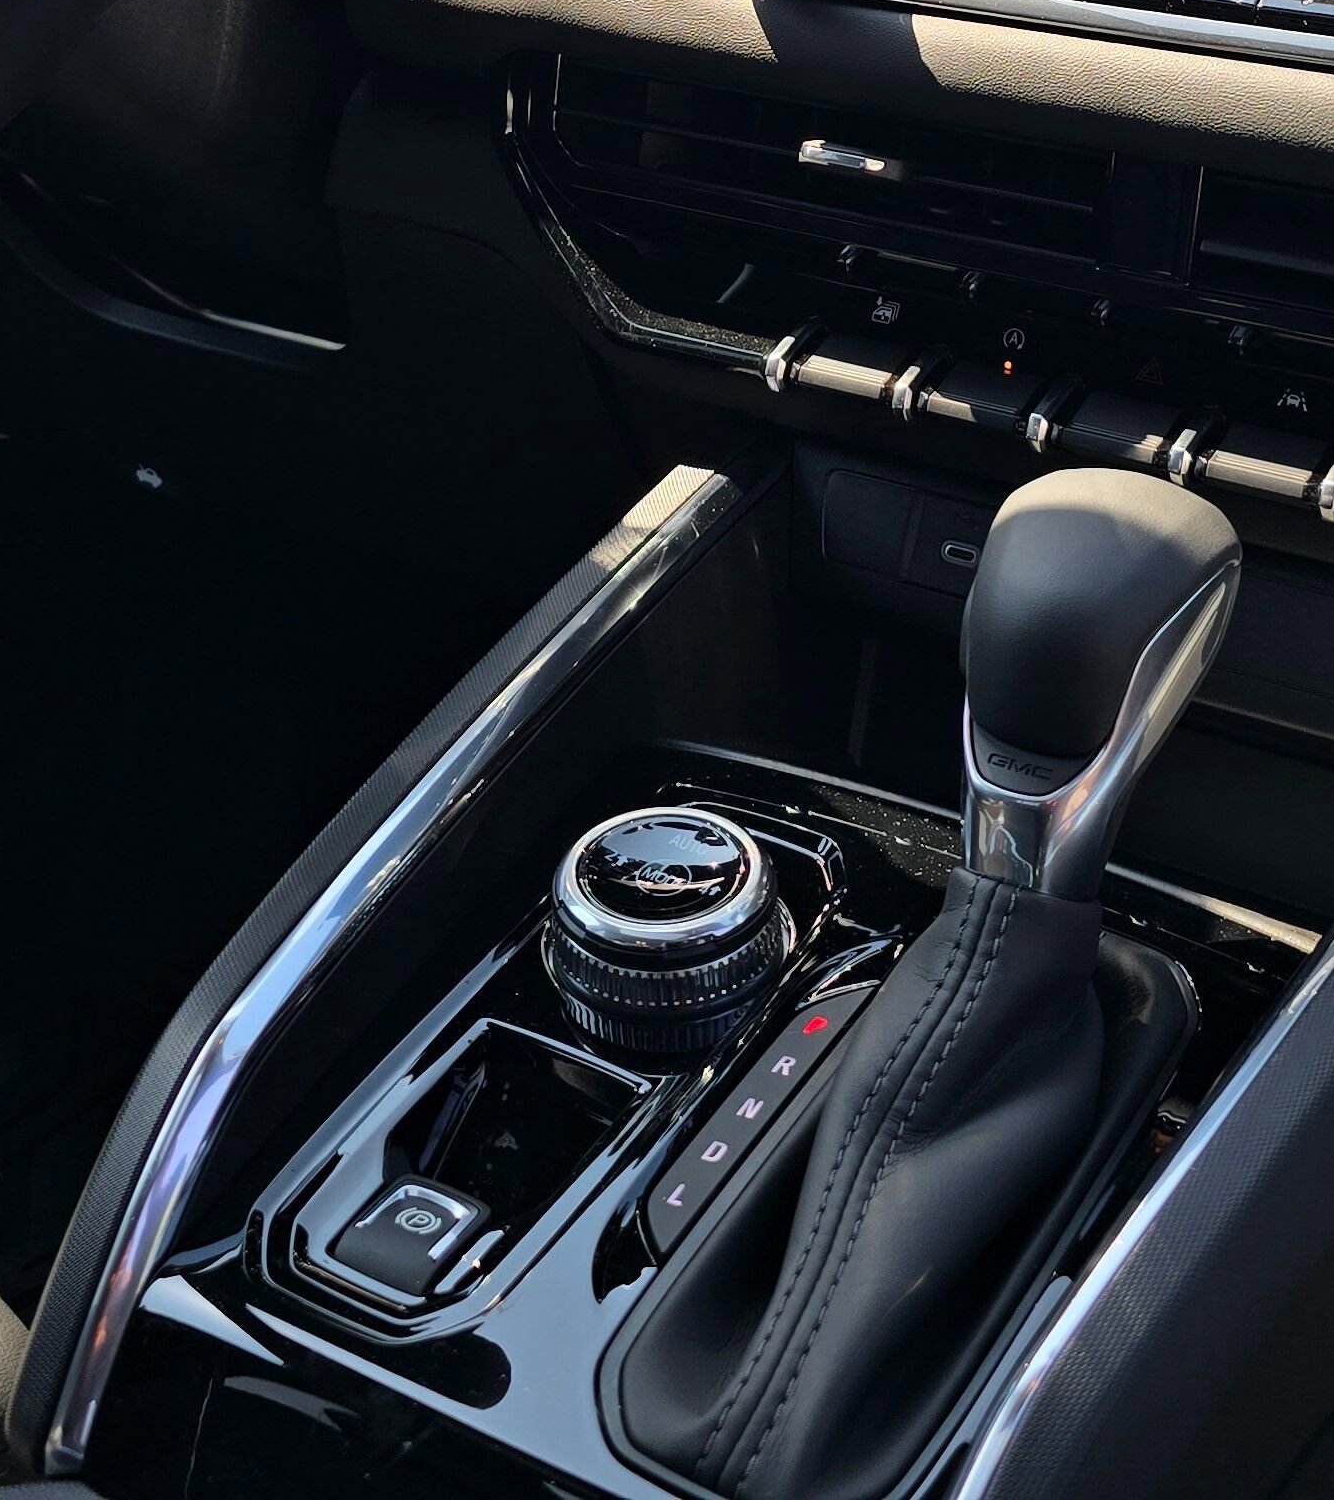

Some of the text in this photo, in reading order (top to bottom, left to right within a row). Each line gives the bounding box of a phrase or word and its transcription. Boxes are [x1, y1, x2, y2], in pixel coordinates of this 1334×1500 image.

[987, 752, 1054, 781] GMC
[668, 832, 709, 856] AUTO
[802, 1015, 828, 1035] P
[770, 1054, 797, 1076] R
[735, 1097, 764, 1120] N
[700, 1140, 729, 1163] D
[666, 1182, 686, 1207] L
